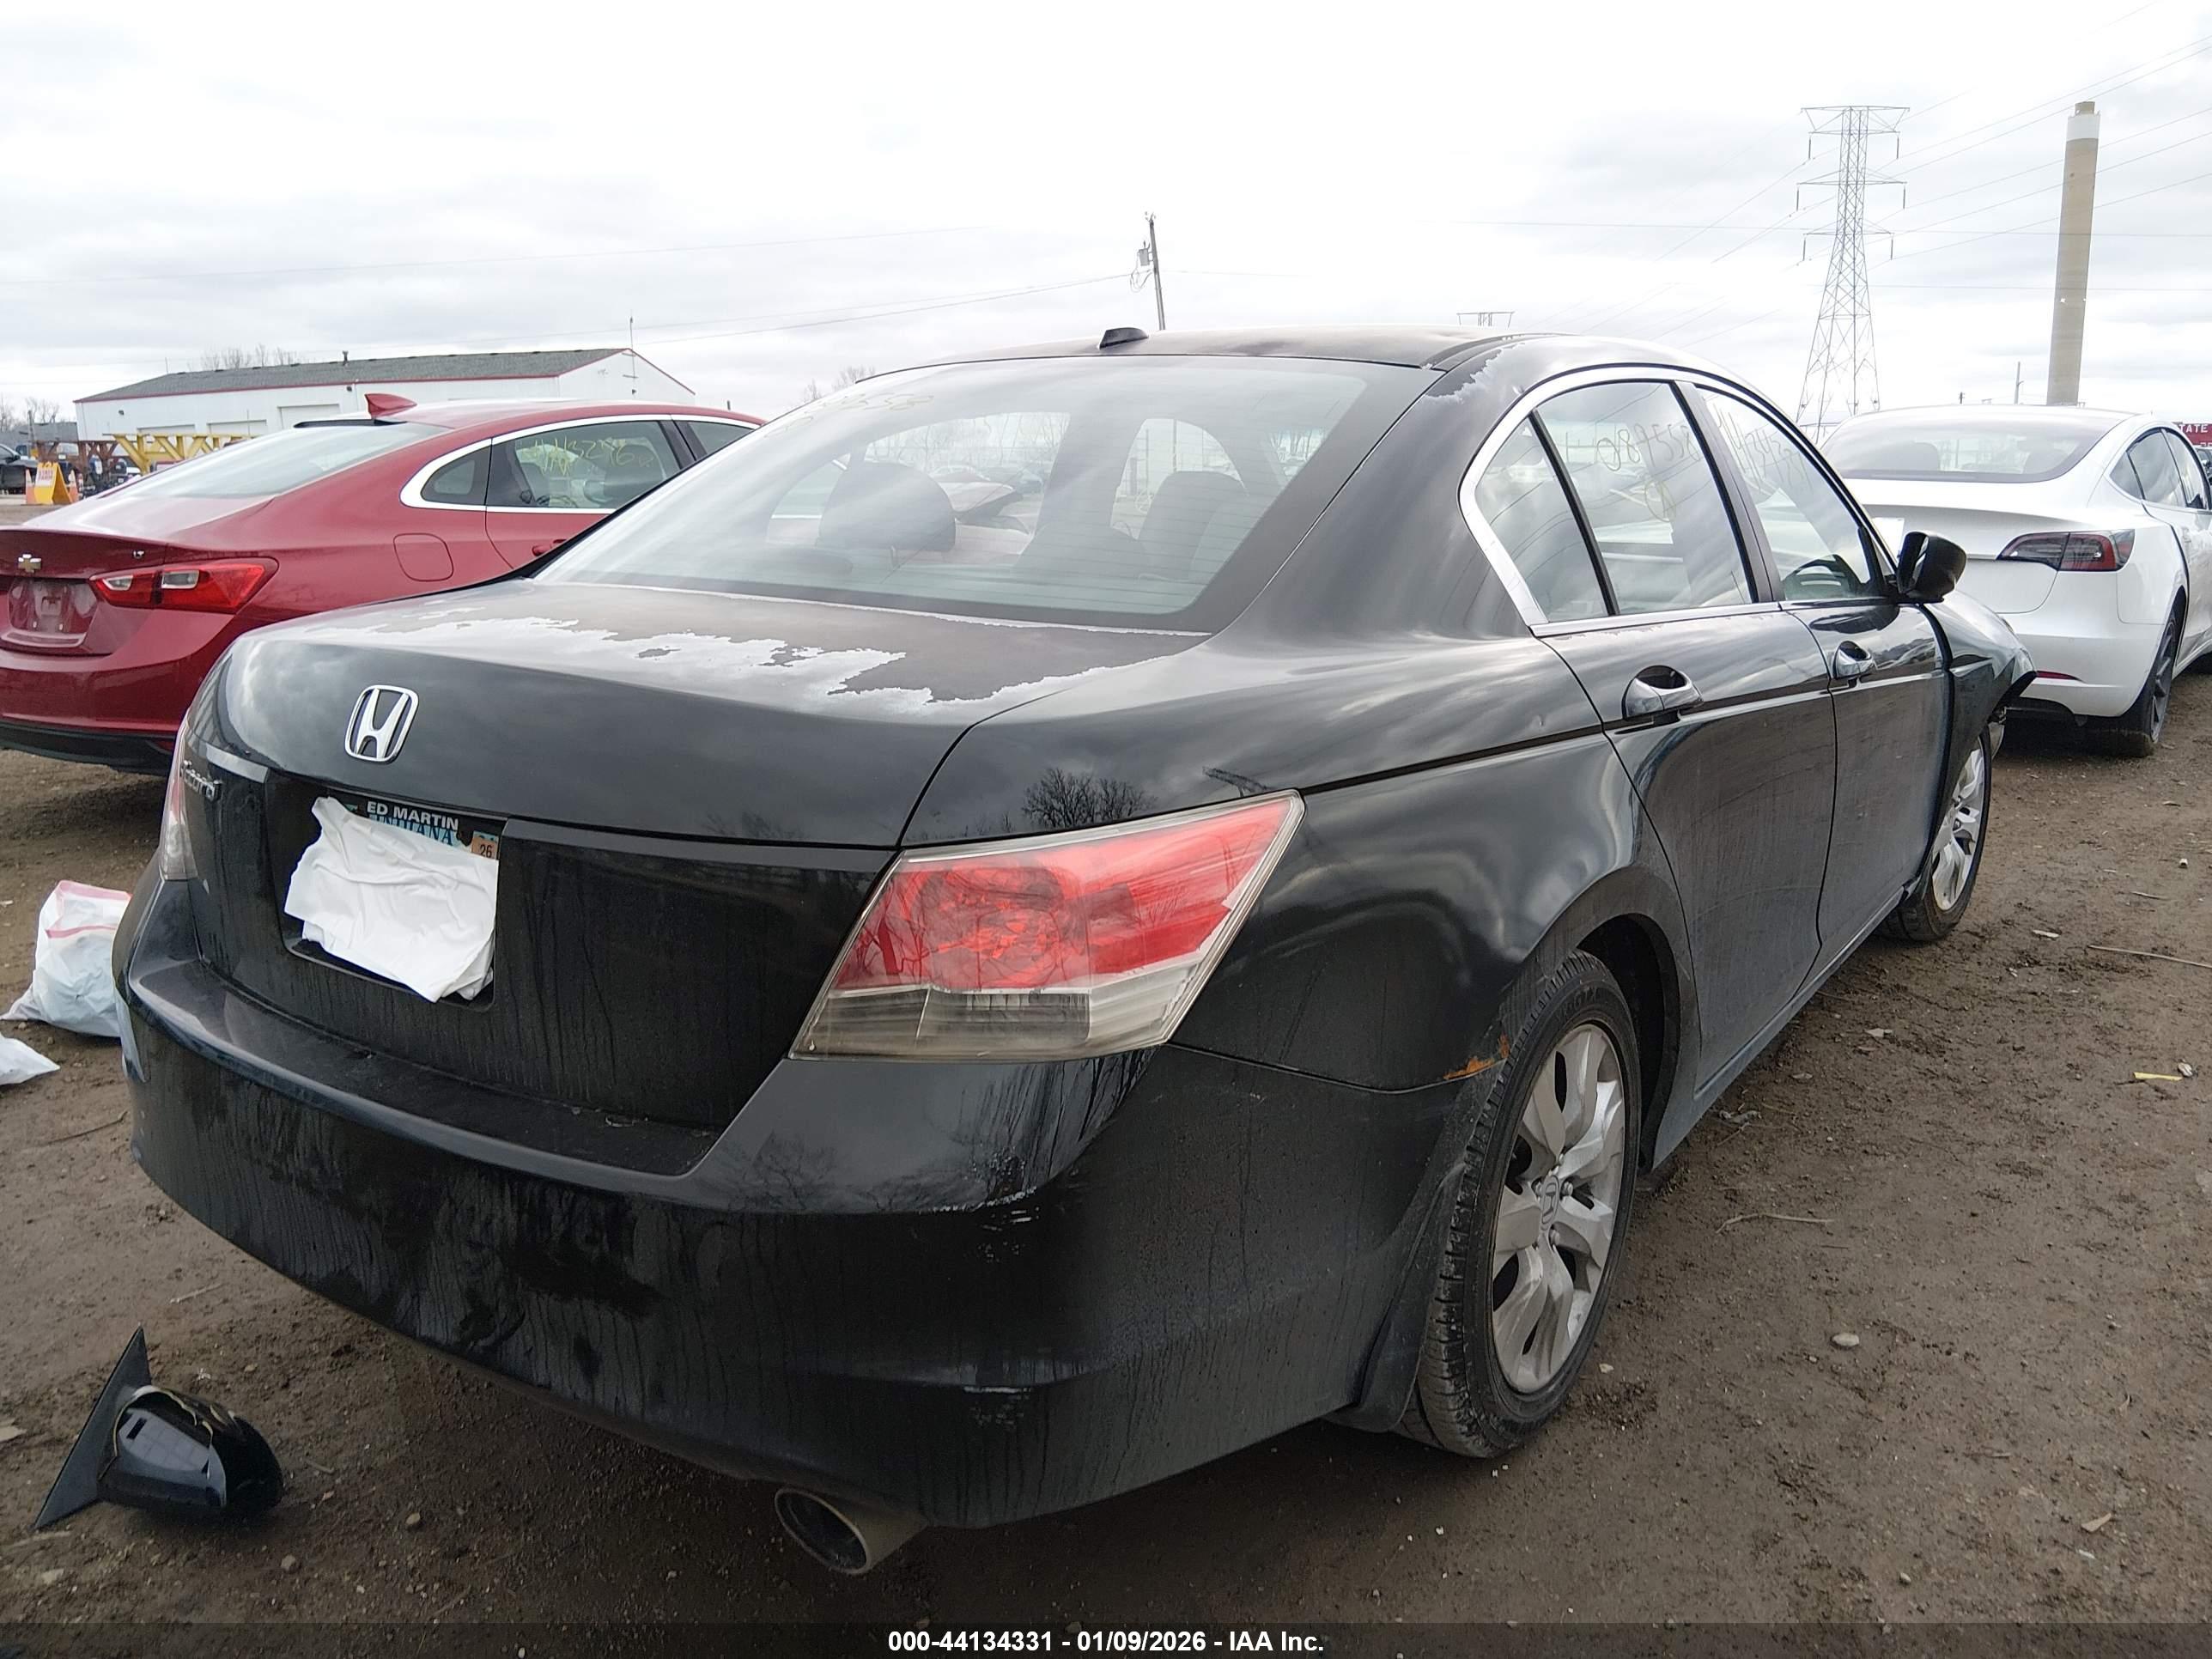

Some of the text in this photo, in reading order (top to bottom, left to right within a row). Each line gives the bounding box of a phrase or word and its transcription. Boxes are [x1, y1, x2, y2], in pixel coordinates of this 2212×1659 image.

[367, 800, 459, 830] ED MARTIN
[479, 843, 493, 858] 26
